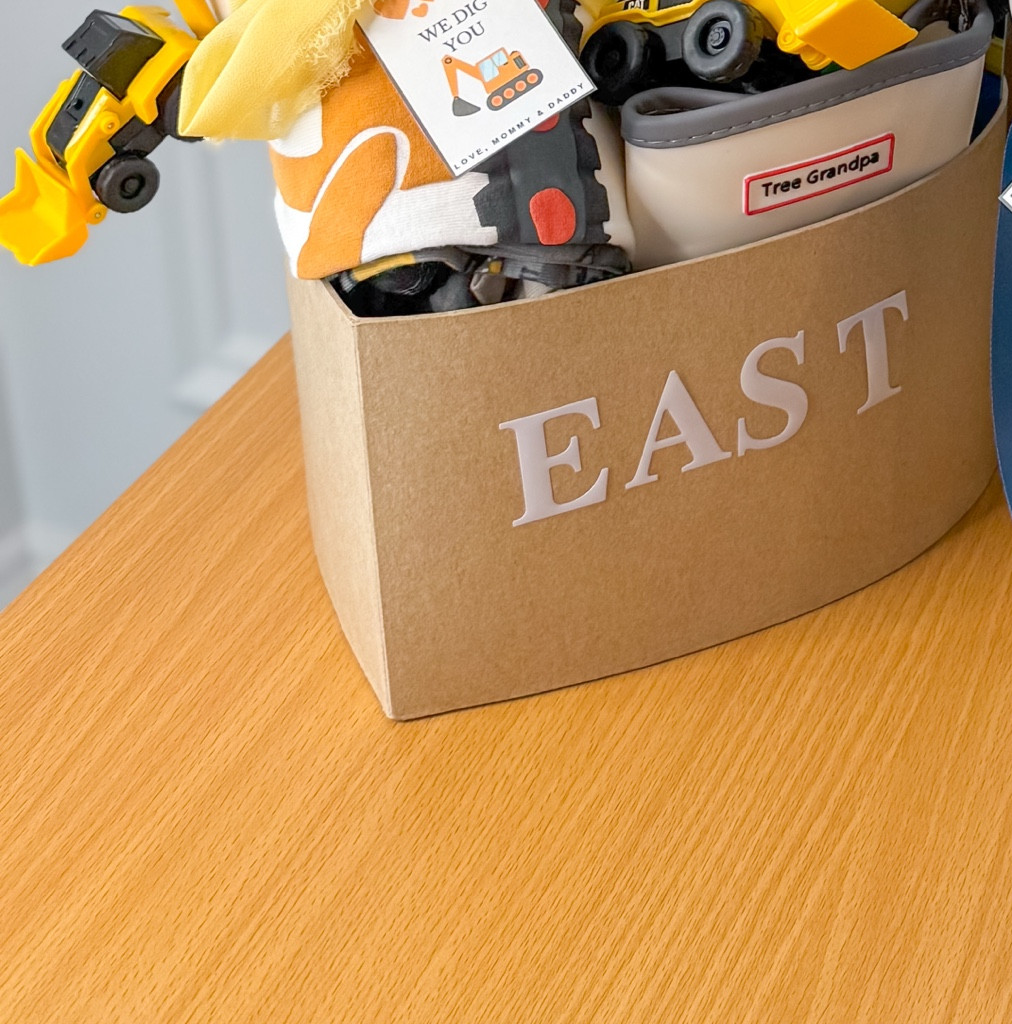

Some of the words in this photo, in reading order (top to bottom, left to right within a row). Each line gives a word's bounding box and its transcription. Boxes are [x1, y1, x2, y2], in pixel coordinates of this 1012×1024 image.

[418, 18, 453, 43] WE
[443, 21, 486, 53] YOU
[453, 147, 489, 170] LOVE,
[491, 116, 532, 145] MOMMY
[547, 82, 585, 110] DADDY
[761, 177, 802, 197] Tree
[806, 151, 880, 184] Grandpa
[498, 290, 909, 527] EAST
